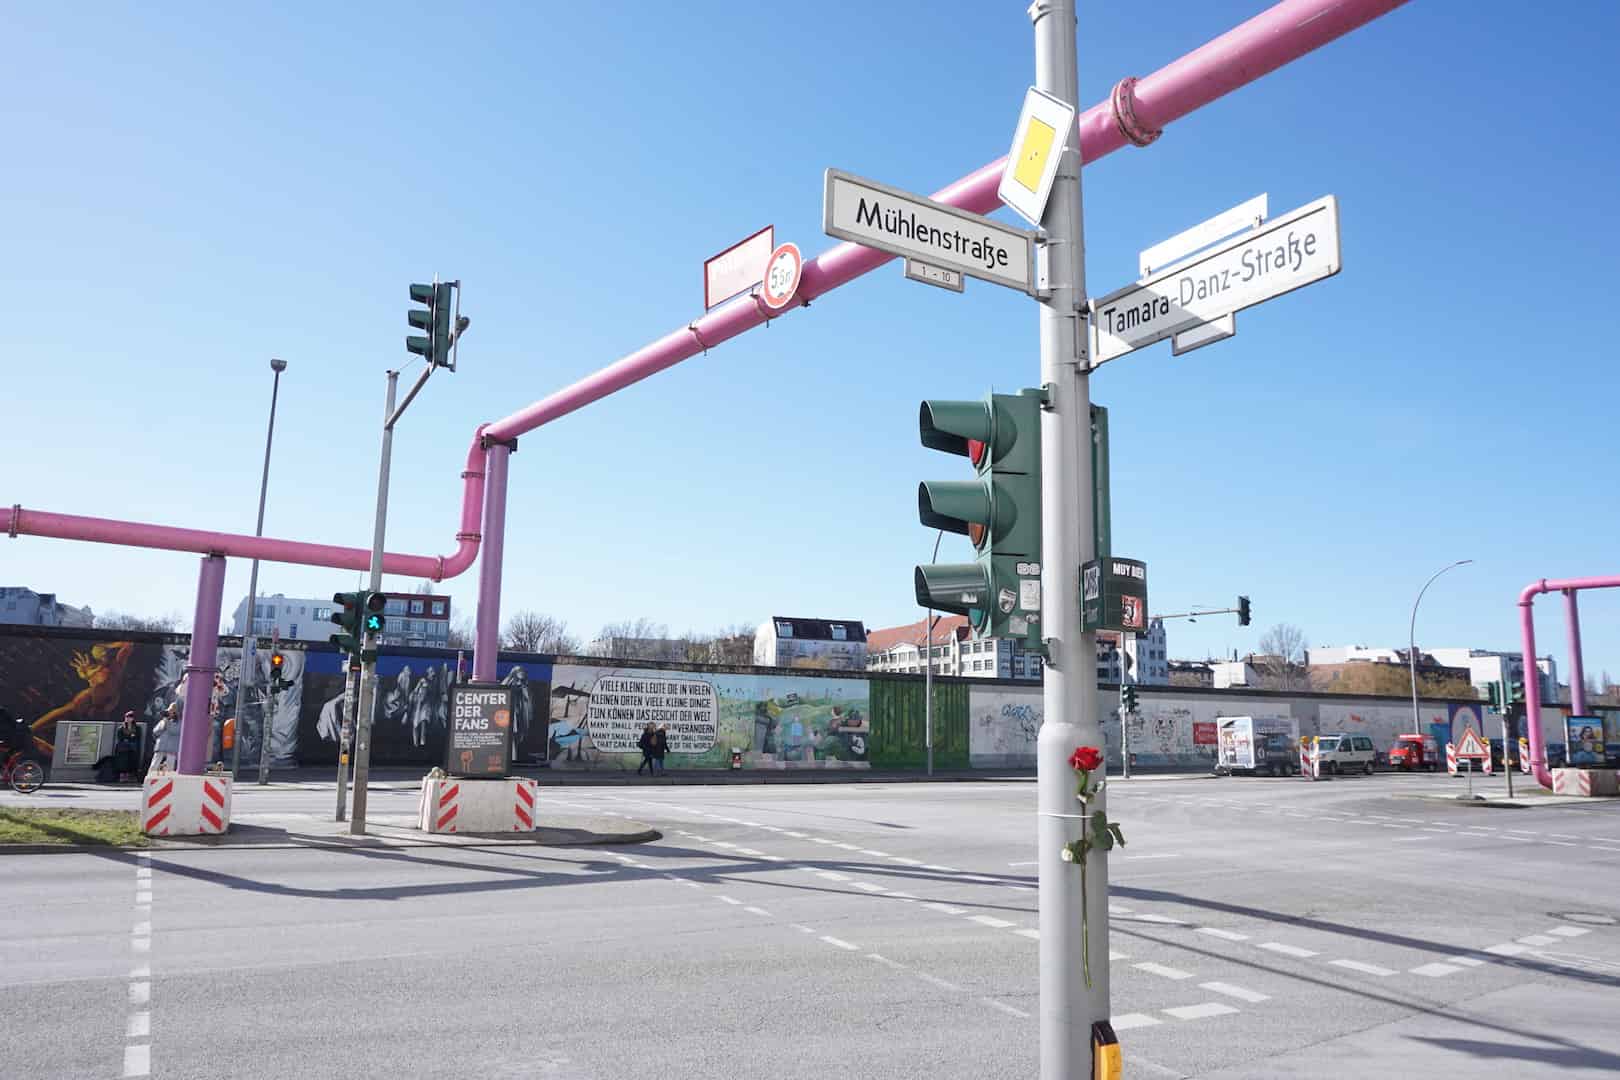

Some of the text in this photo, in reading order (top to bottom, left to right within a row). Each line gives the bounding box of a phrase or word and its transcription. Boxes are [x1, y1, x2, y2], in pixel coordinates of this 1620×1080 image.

[856, 198, 1008, 269] Mühlenstraße
[1104, 231, 1317, 336] Tamara-Danz-Straße
[600, 680, 711, 696] VIELE KLEINE LEUTE DIE IN VIELEN
[455, 692, 506, 705] CENTER
[592, 694, 711, 708] KLEINEN ORTEN VIELE KLEINE DINGE
[455, 705, 481, 718] DER
[607, 707, 634, 720] KÖNNEN
[636, 709, 650, 720] DAS
[651, 710, 678, 721] GESICHT
[679, 710, 693, 721] DER
[693, 711, 711, 722] WELT
[455, 718, 489, 730] FANS
